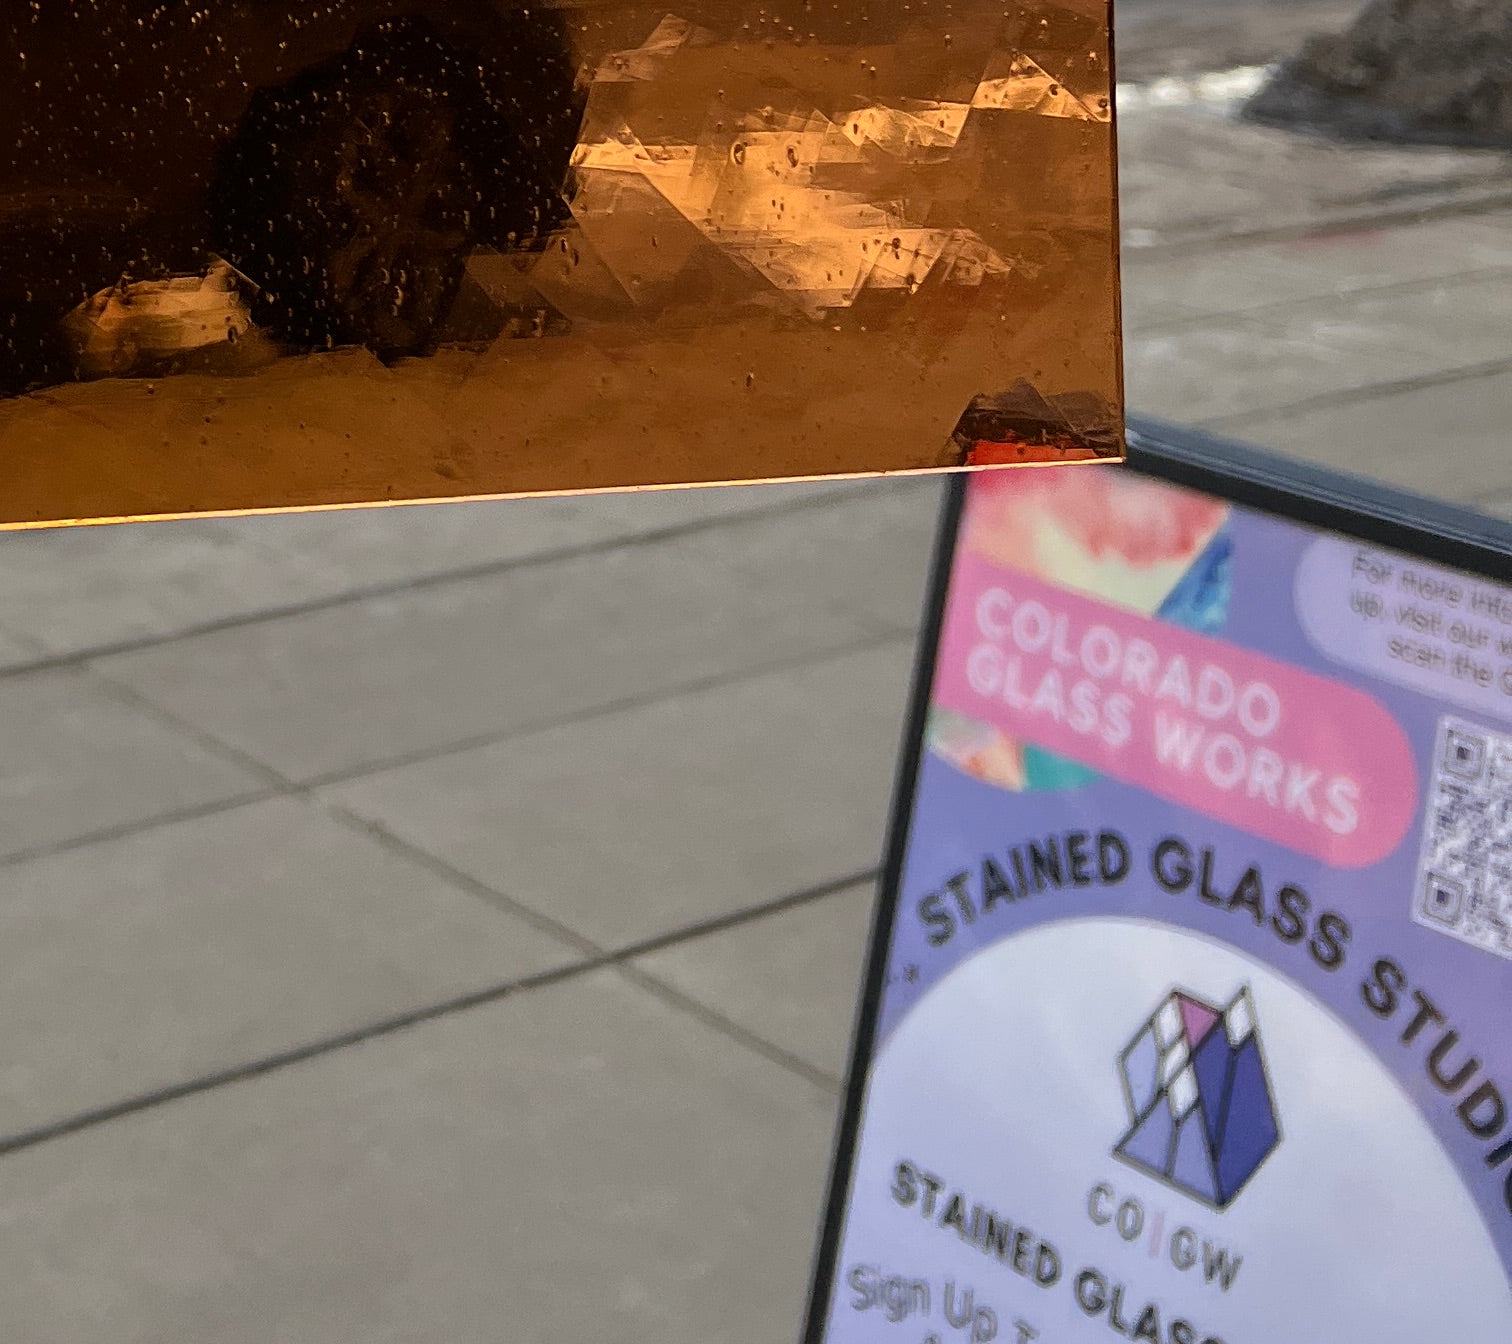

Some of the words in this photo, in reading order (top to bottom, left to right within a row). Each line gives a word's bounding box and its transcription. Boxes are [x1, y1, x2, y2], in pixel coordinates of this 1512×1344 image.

[974, 587, 1281, 737] COLORADO
[966, 648, 1133, 748] GLASS
[1152, 717, 1360, 837] WORKS
[916, 830, 1131, 949] STAINED
[1150, 836, 1353, 972] GLASS
[1359, 957, 1512, 1214] STUDI
[890, 1159, 1062, 1289] STAINED
[847, 1263, 931, 1323] Sign
[941, 1279, 999, 1344] Up
